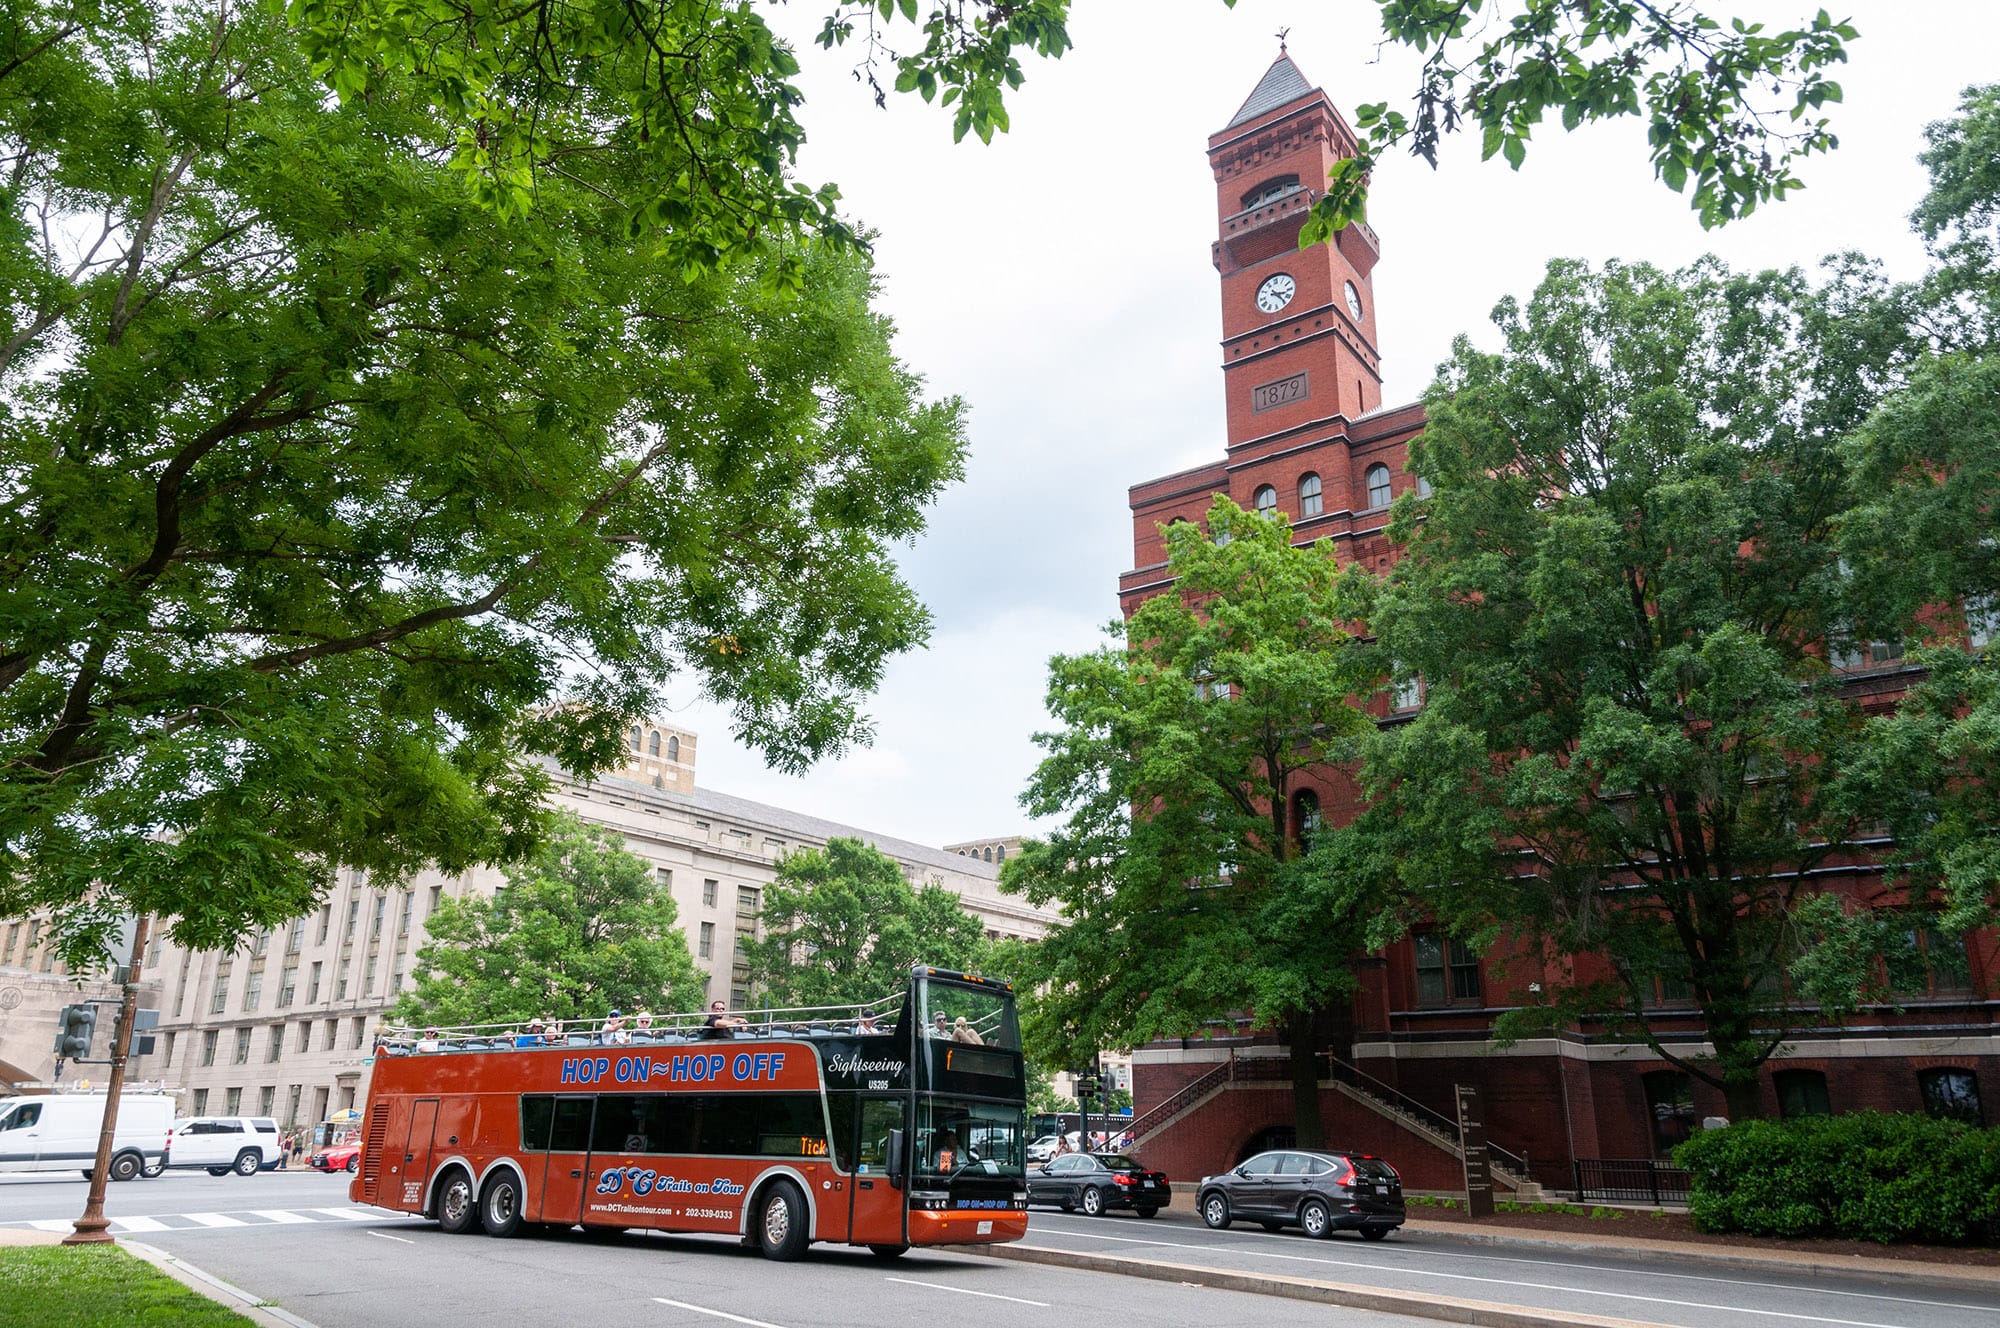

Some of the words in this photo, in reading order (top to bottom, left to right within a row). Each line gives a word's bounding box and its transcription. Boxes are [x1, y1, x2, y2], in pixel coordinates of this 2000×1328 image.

[1262, 379, 1300, 406] 1879
[561, 1058, 609, 1083] HOP
[615, 1056, 651, 1082] ON
[671, 1054, 726, 1081] HOP
[732, 1053, 785, 1081] OFF
[828, 1053, 905, 1079] Sightseeing
[656, 1176, 693, 1193] Trails
[693, 1183, 709, 1193] on
[711, 1178, 744, 1195] Tour
